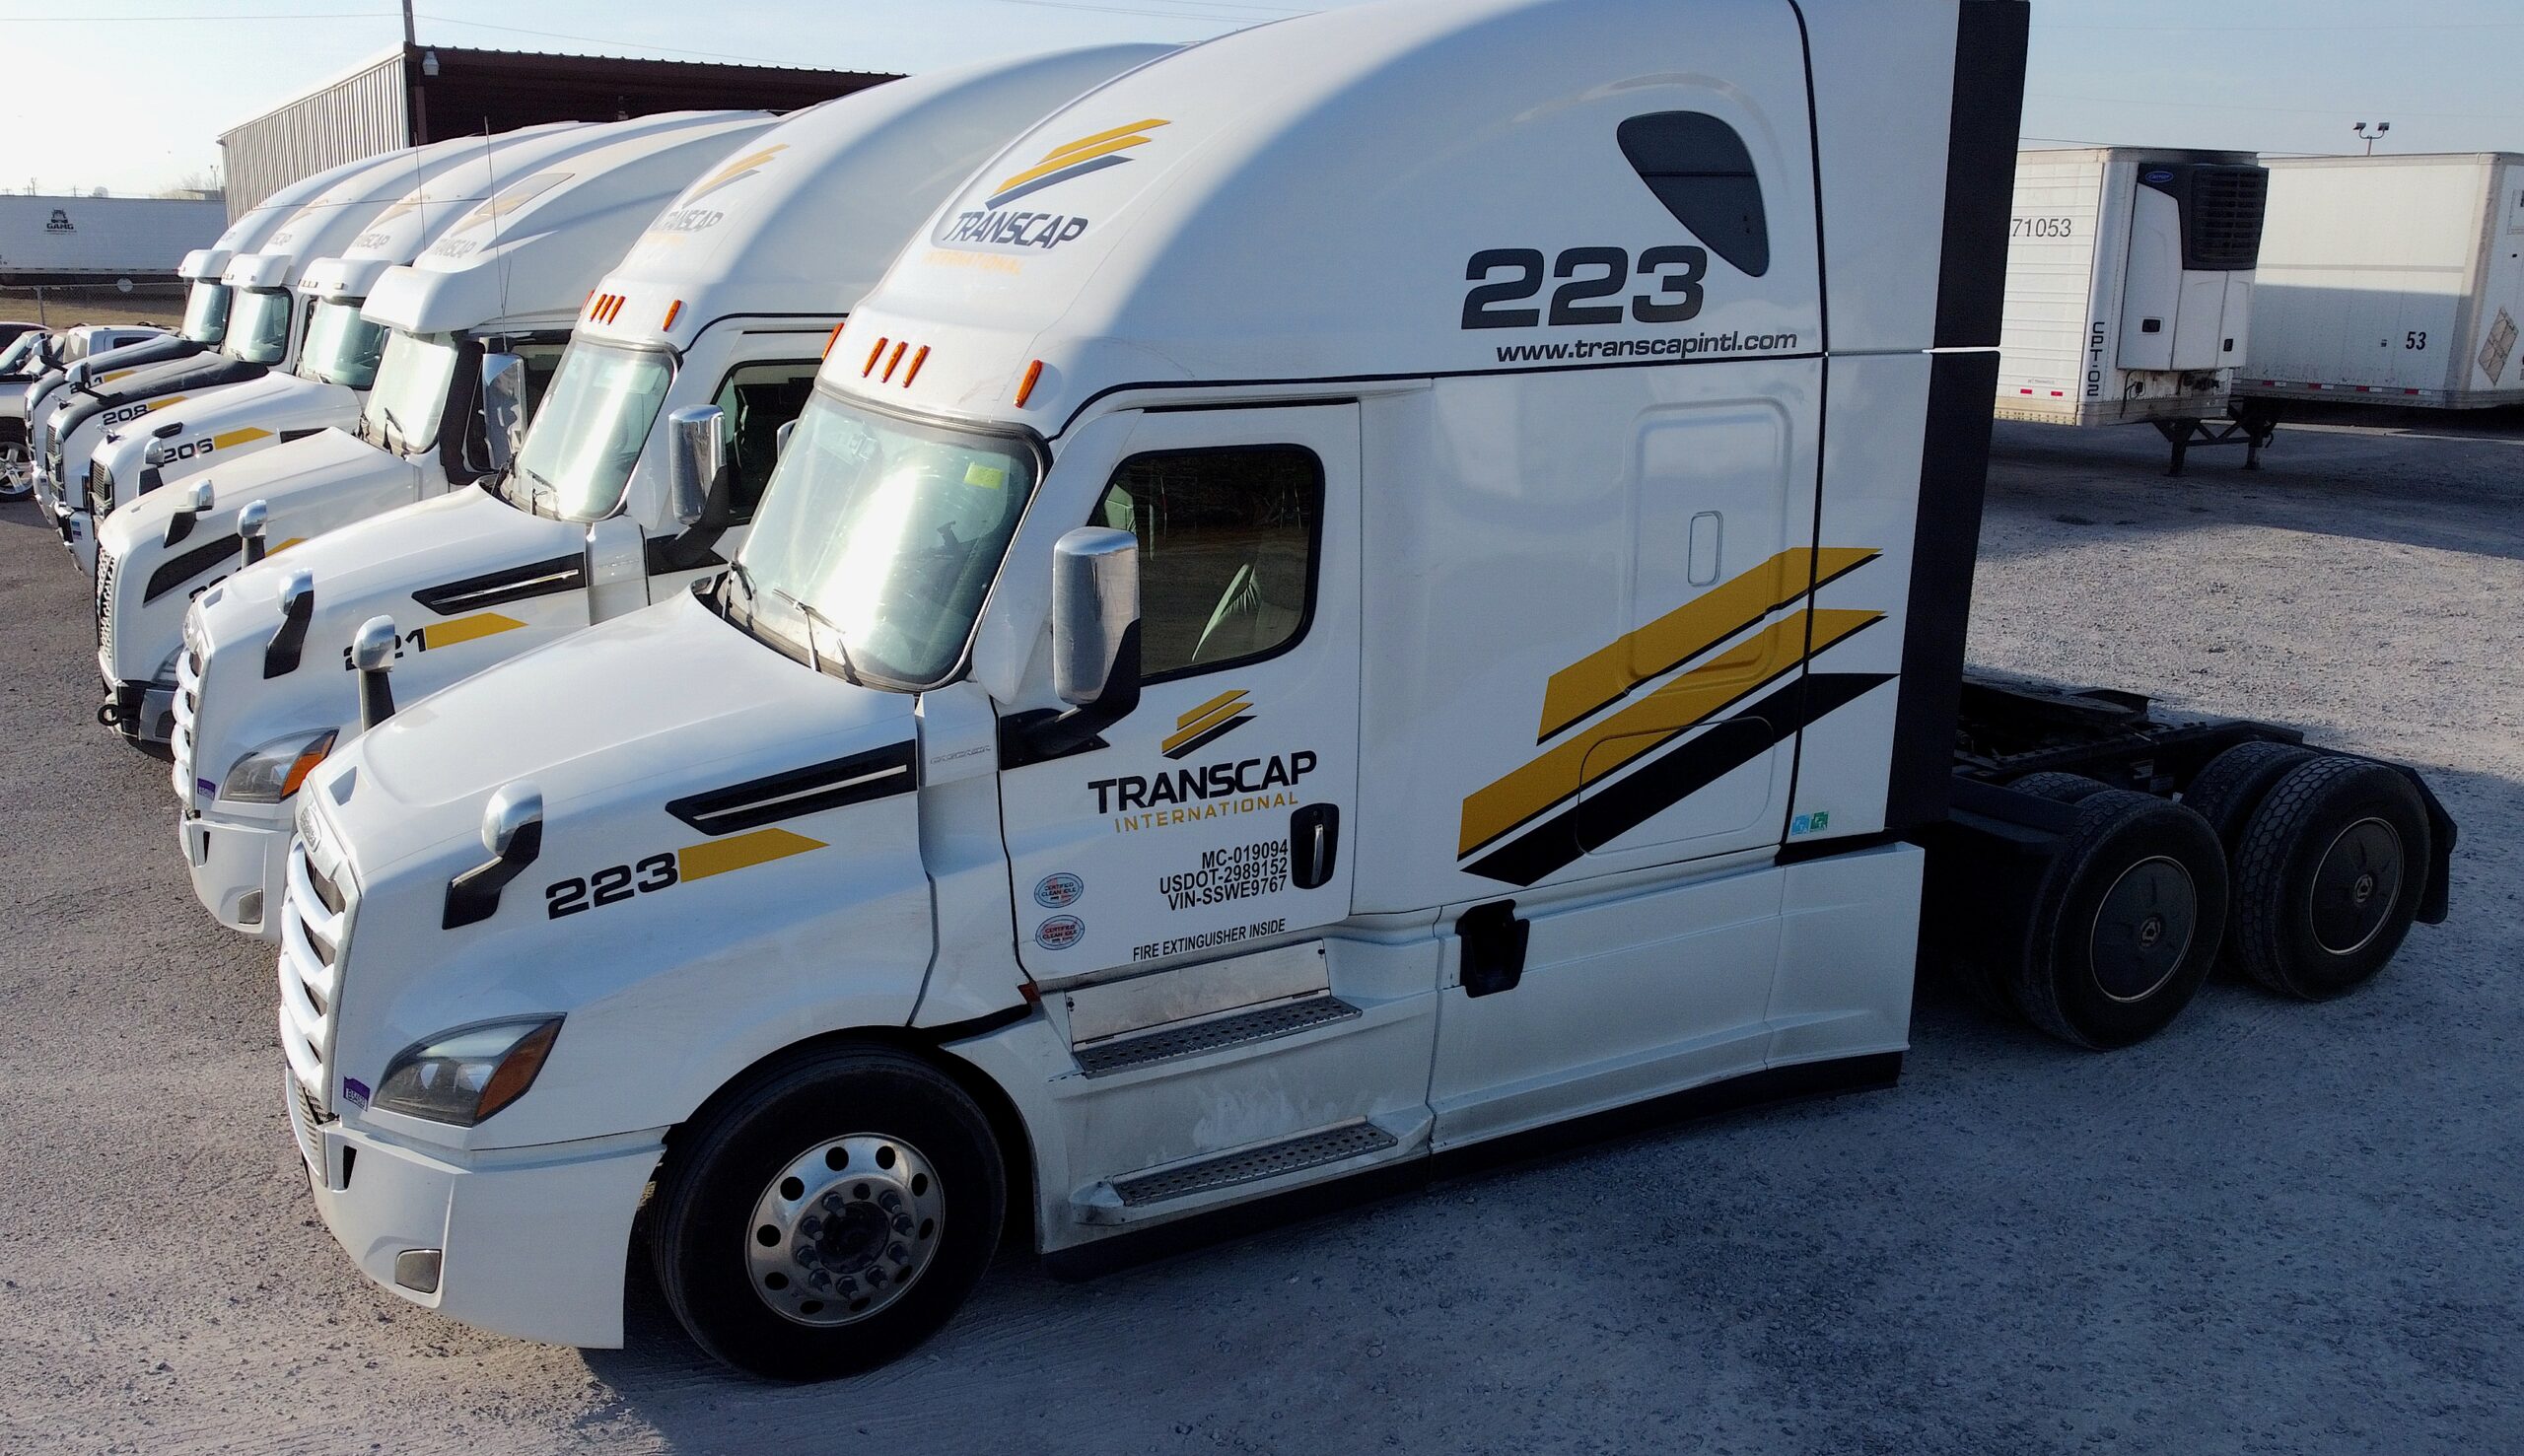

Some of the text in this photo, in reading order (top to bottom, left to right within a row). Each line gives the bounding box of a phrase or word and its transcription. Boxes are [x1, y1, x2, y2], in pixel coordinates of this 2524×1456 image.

[943, 211, 1088, 249] TRANSCAP
[2012, 218, 2071, 237] 71053
[1461, 244, 1708, 330] 223
[1497, 330, 1797, 363] www.transcapintl.com
[2406, 331, 2426, 350] 53
[164, 437, 214, 464] 206
[1087, 750, 1317, 814] TRANSCAP
[1114, 792, 1298, 833] INTERNATIONAL
[1202, 839, 1289, 869] MC-019094
[545, 852, 678, 920] 223
[1159, 857, 1288, 894] USDOT-2989152
[1167, 874, 1288, 911] VIN-SSWE9767
[1133, 918, 1286, 961] FIRE EXTINGUISHER INSIDE
